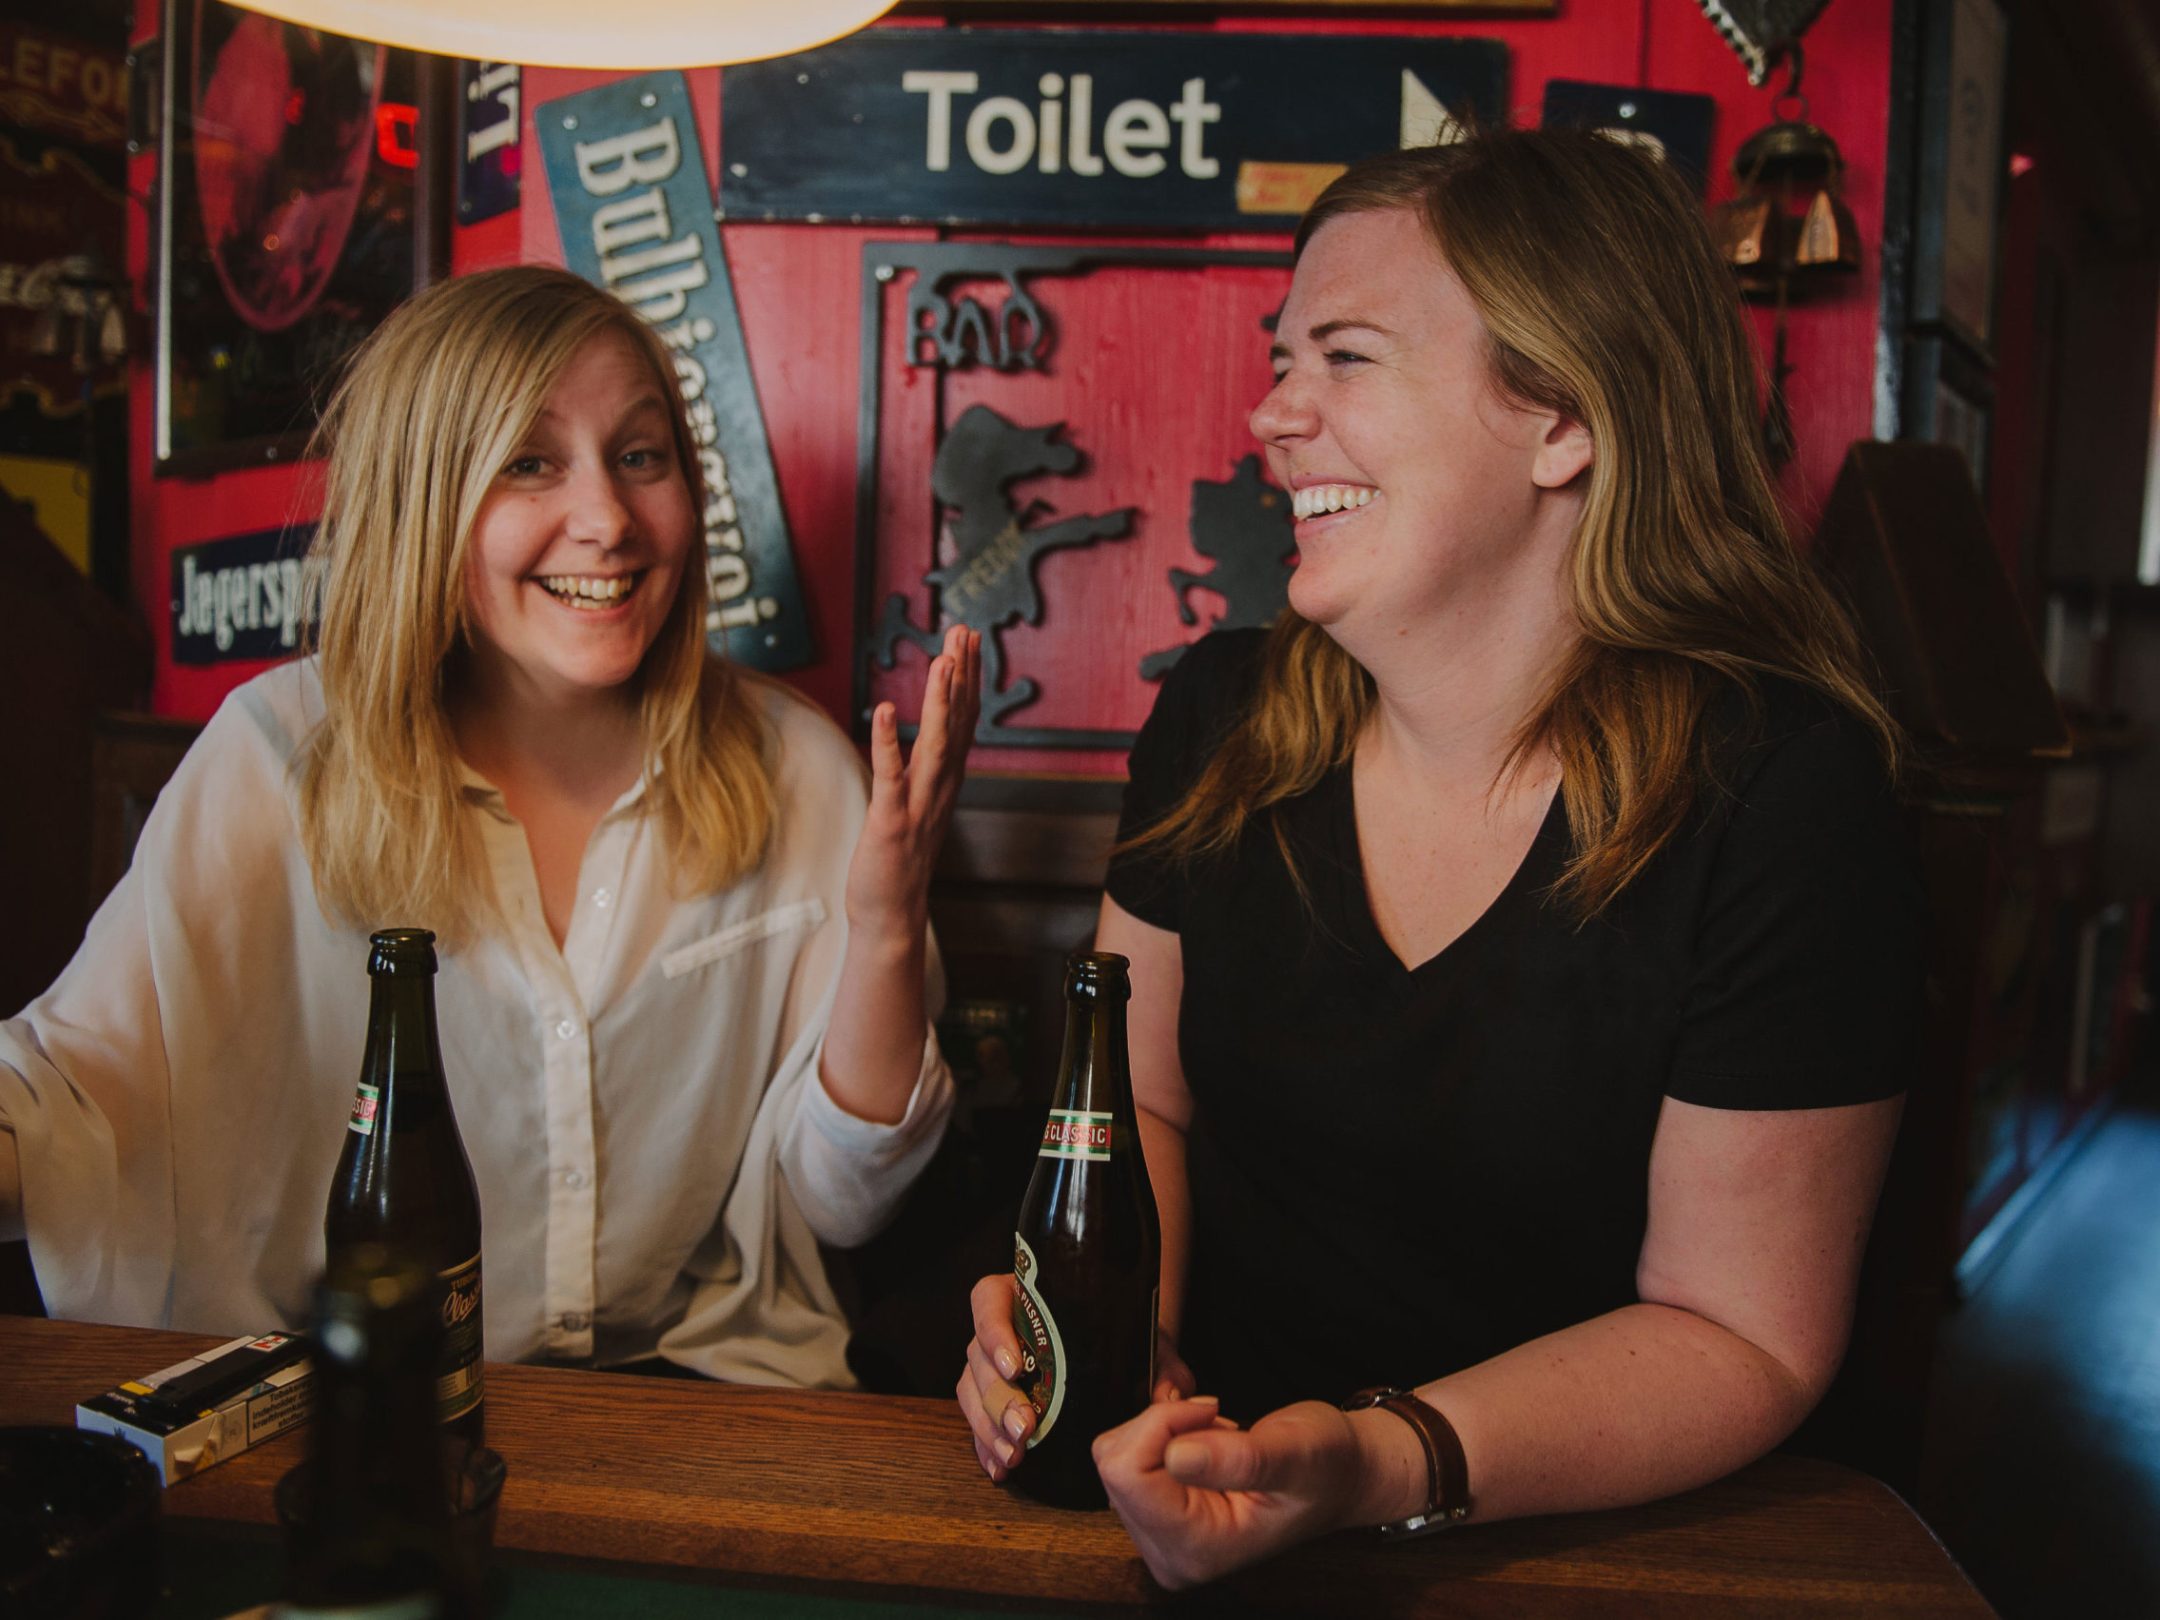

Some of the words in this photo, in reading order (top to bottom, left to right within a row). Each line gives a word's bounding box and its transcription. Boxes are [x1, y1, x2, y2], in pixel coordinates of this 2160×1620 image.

[0, 38, 129, 113] EFO
[468, 64, 520, 164] Li
[902, 70, 1222, 179] Toilet
[905, 292, 1042, 369] BAR
[1050, 1123, 1106, 1145] CLASSIC
[1021, 1291, 1048, 1347] PILSNER
